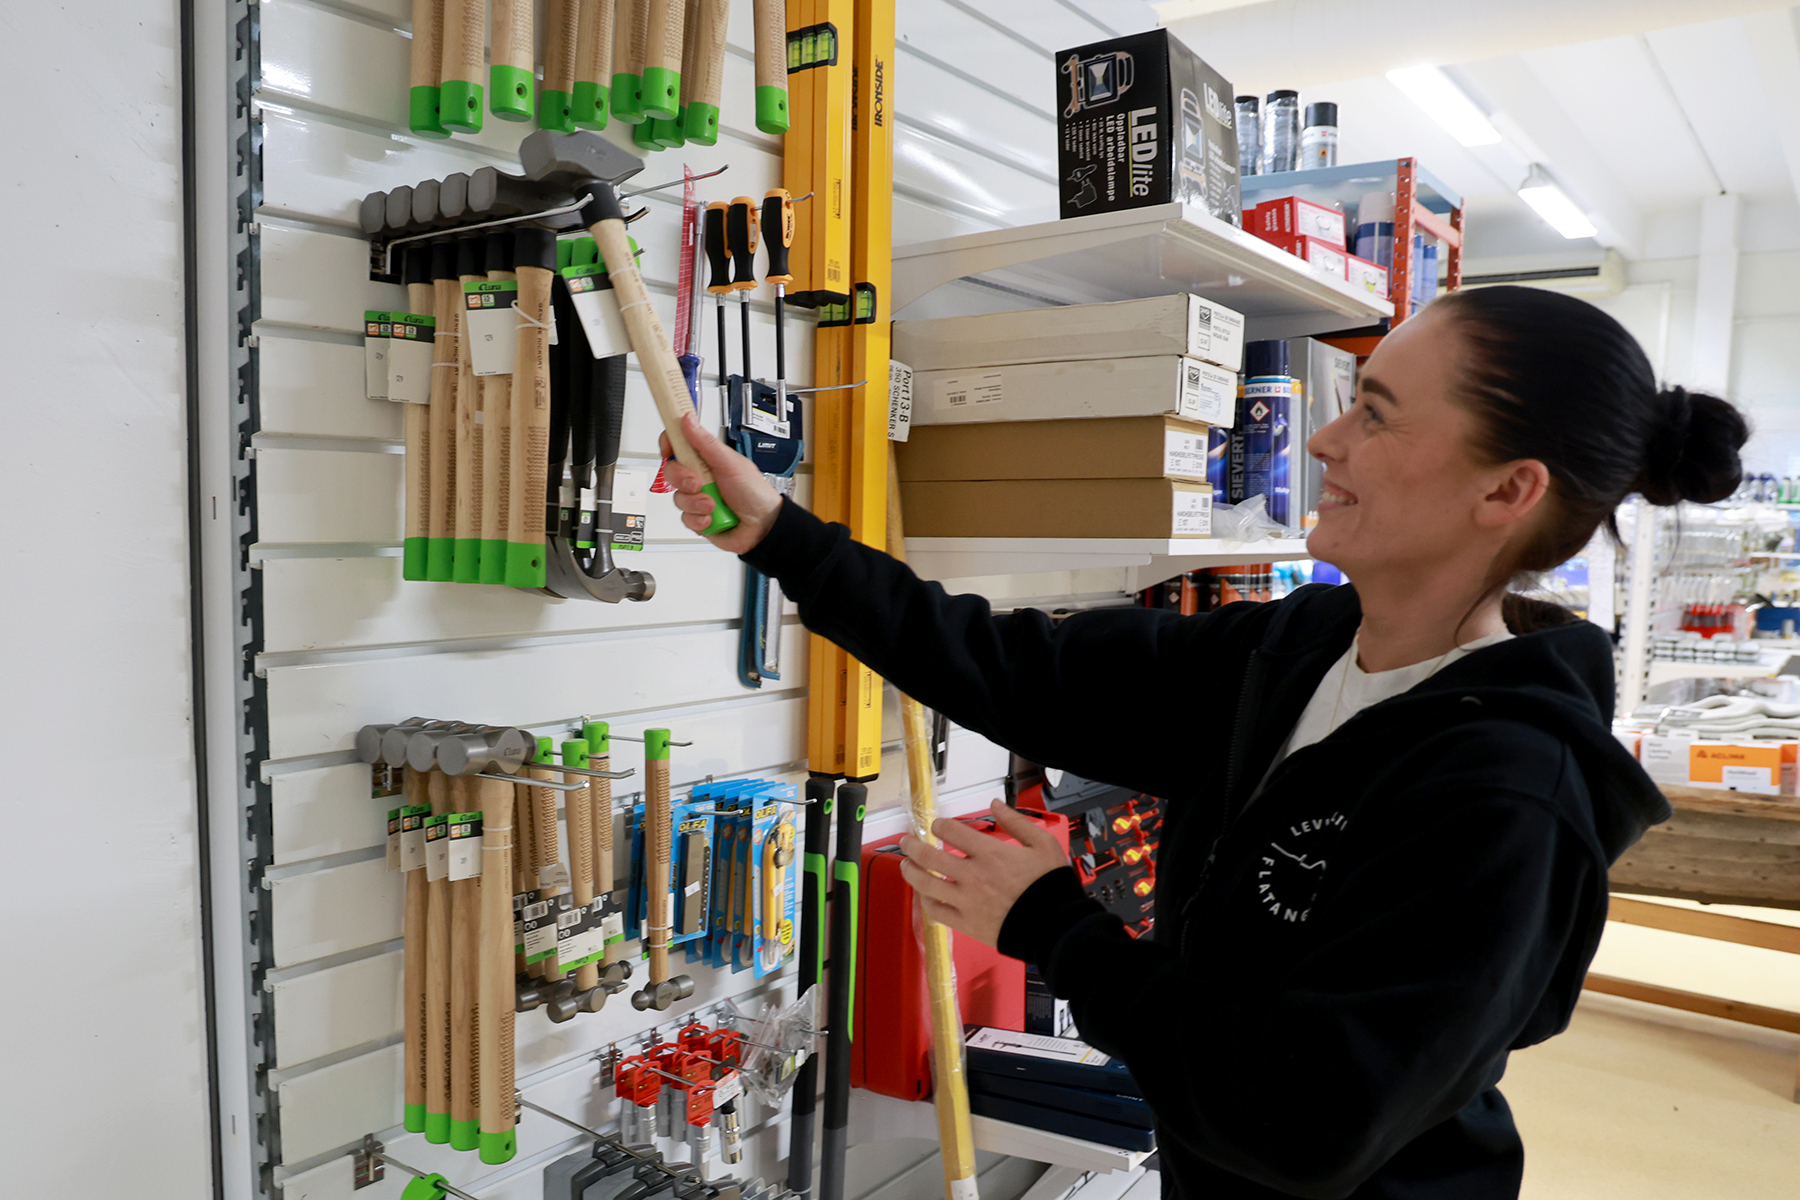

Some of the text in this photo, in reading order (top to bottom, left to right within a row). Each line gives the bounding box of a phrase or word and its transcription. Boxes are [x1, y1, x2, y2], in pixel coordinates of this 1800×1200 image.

[875, 59, 883, 127] IRONSIDE
[1106, 115, 1115, 202] LED arbeidslampe
[1116, 113, 1125, 162] Oppladbar
[1131, 106, 1157, 197] LEDlite
[888, 385, 900, 429] SCHENKER
[899, 370, 911, 422] Port 13-B
[1231, 434, 1243, 499] SIEVERT
[679, 819, 707, 832] OLFA
[755, 805, 777, 820] OLFA
